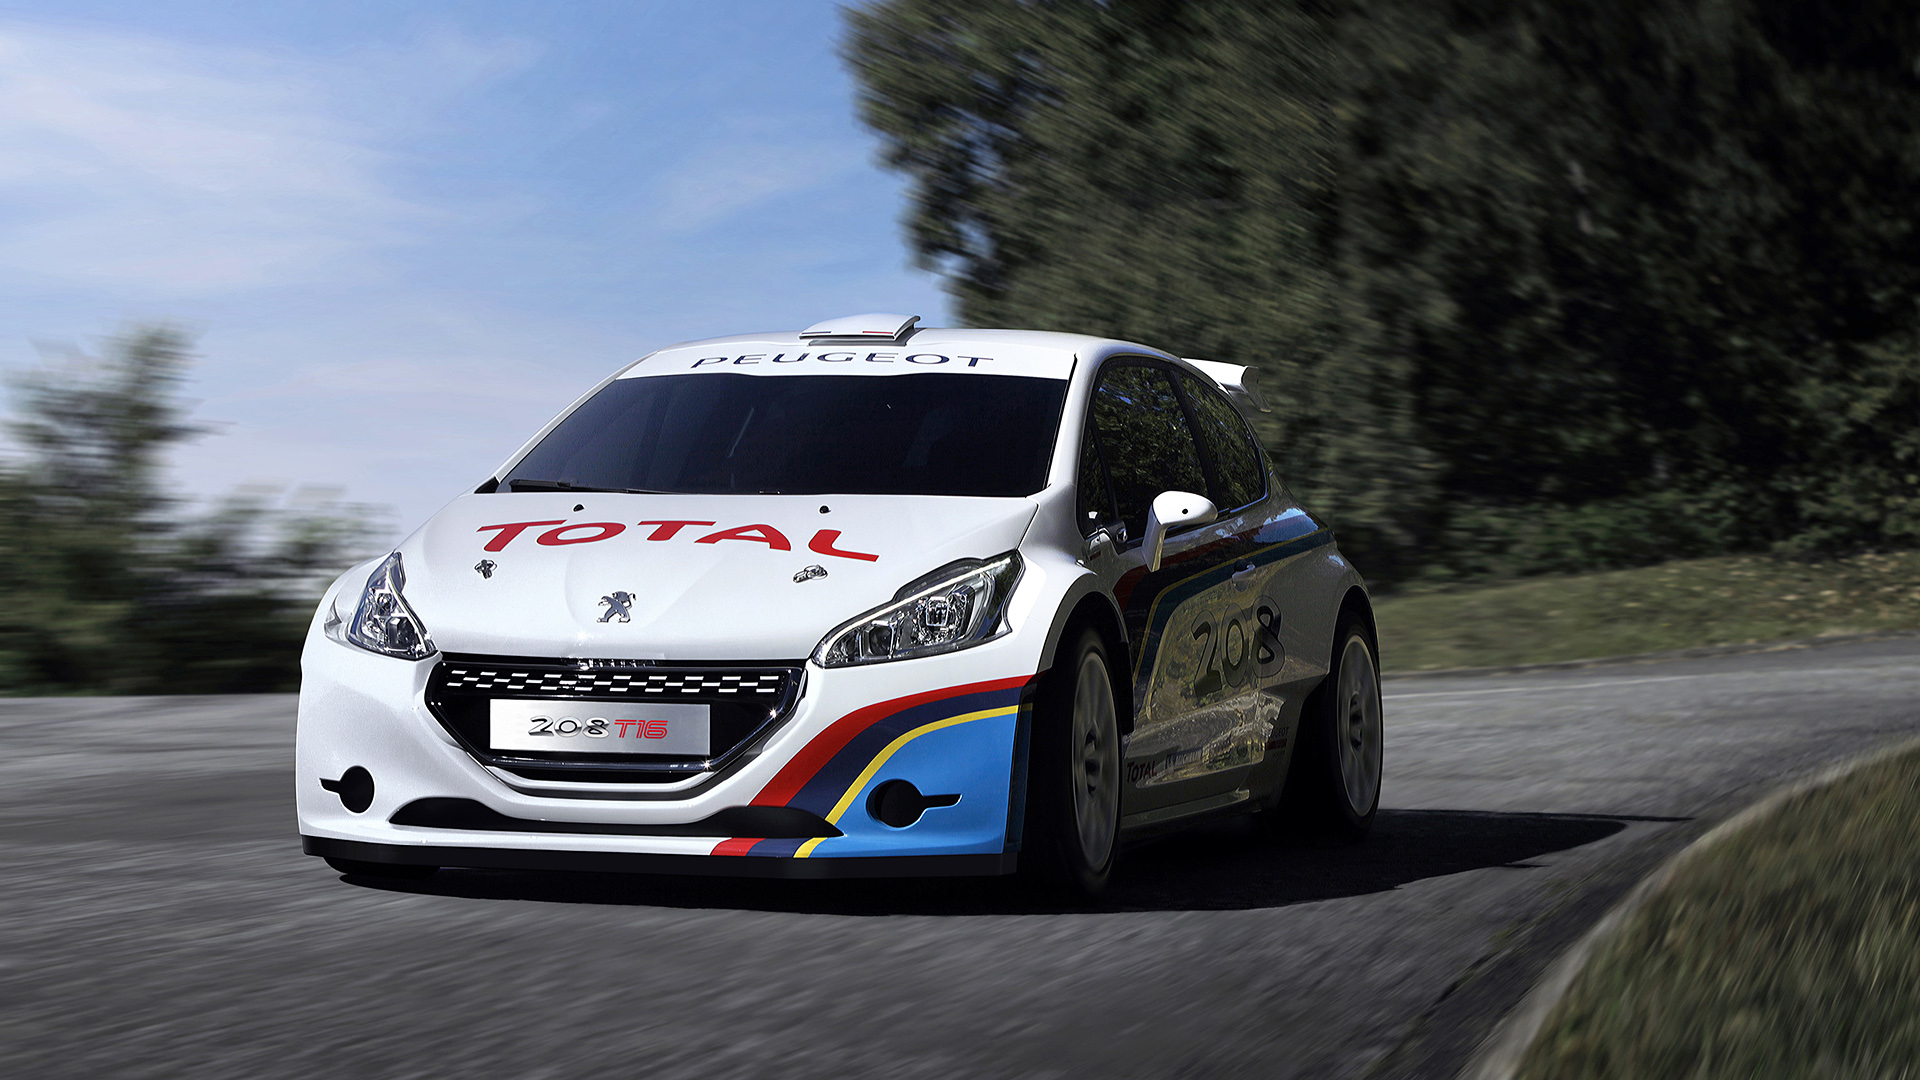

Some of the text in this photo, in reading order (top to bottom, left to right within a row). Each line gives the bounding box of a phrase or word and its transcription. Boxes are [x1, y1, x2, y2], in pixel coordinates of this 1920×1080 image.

[692, 351, 994, 369] PEUGEOT
[477, 518, 880, 562] TOTAL
[1191, 595, 1285, 698] 208
[528, 715, 668, 739] 208 T16
[1126, 760, 1158, 783] TOTAL
